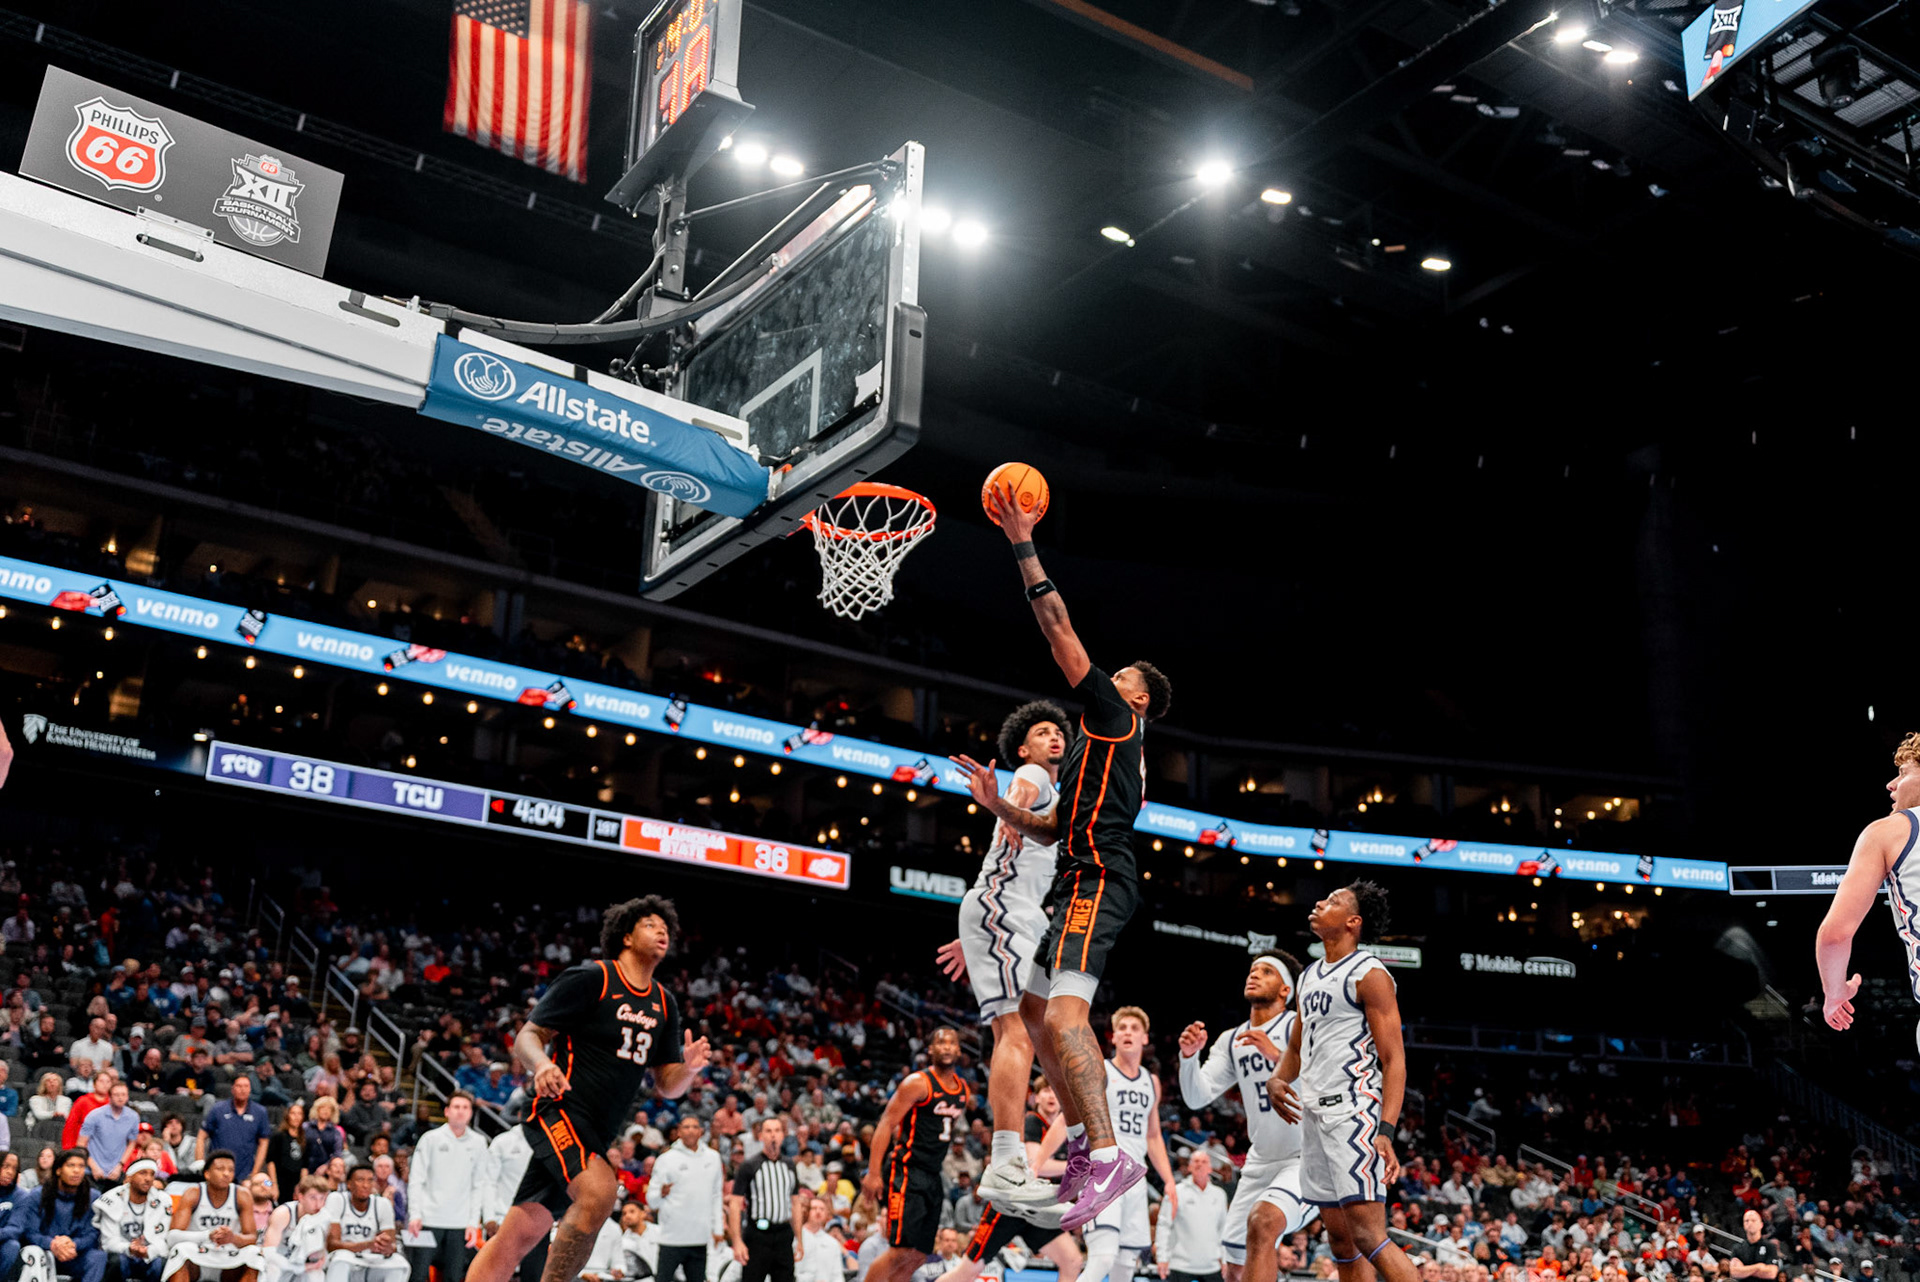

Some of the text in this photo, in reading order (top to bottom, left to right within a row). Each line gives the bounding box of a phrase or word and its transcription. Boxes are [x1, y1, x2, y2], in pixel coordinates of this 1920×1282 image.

[90, 109, 159, 145] PHILLIPS
[86, 136, 149, 175] 66
[262, 162, 277, 174] 66
[230, 166, 298, 216] XII
[219, 206, 296, 237] TOURNAMENT
[223, 200, 294, 230] BASKETBALL
[516, 381, 651, 444] Allstate
[482, 417, 647, 473] Allstate
[137, 597, 219, 629] venmo
[297, 632, 374, 661] venmo
[446, 664, 517, 691] venmo
[584, 692, 650, 719] venmo
[712, 719, 775, 745] venmo
[220, 752, 263, 778] TCU
[832, 744, 891, 769] venmo
[289, 761, 335, 795] 38
[393, 781, 444, 810] TCU
[512, 799, 565, 829] 4:04
[1148, 811, 1197, 833] venmo
[1241, 830, 1295, 849] venmo
[1349, 841, 1406, 857] venmo
[1459, 850, 1514, 866] venmo
[1566, 858, 1621, 874] venmo
[889, 866, 967, 897] UMB
[1671, 866, 1725, 882] venmo
[1068, 898, 1093, 934] POKES
[1523, 961, 1571, 977] CENTER
[616, 1003, 658, 1030] Cowboys
[1303, 990, 1333, 1018] TCU
[616, 1026, 653, 1065] 13
[1116, 1090, 1149, 1109] TCU
[550, 1119, 574, 1151] POKES
[939, 1116, 952, 1141] 1
[1119, 1110, 1143, 1135] 55
[345, 1224, 371, 1237] TCU
